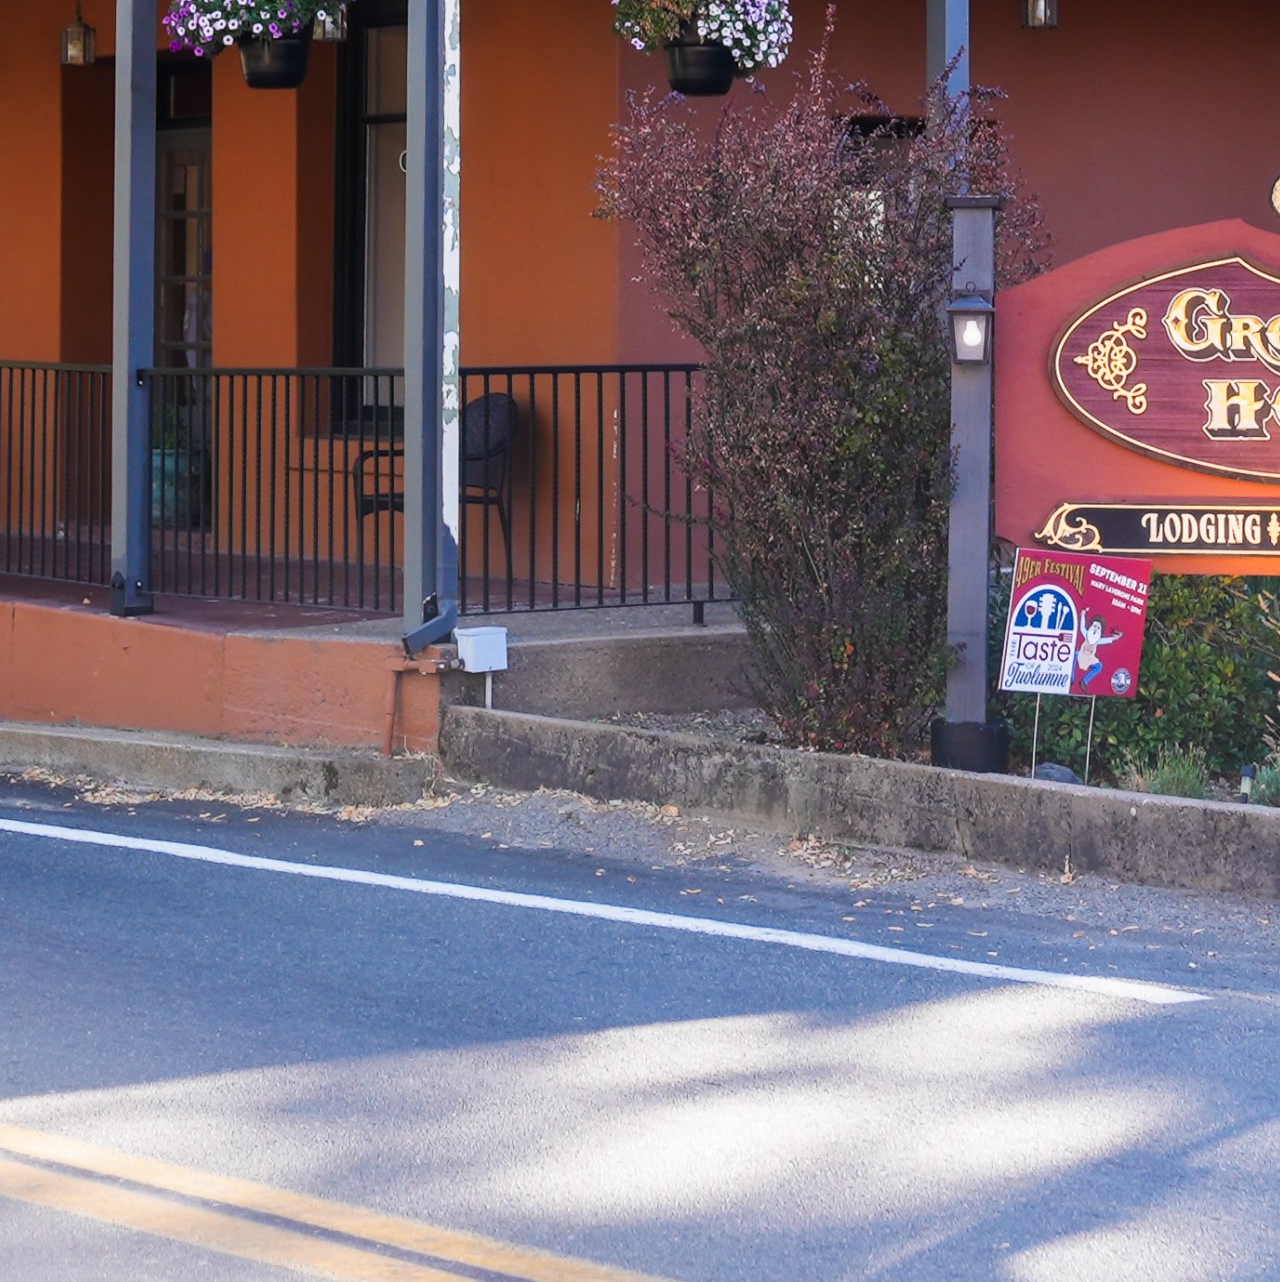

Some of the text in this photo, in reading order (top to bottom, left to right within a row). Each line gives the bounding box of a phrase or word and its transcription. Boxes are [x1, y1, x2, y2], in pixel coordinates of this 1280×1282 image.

[1141, 512, 1261, 544] LODGING
[1089, 563, 1147, 595] SEPTEMBER 21
[1014, 633, 1071, 662] Taste
[1005, 662, 1069, 687] Tuolumne
